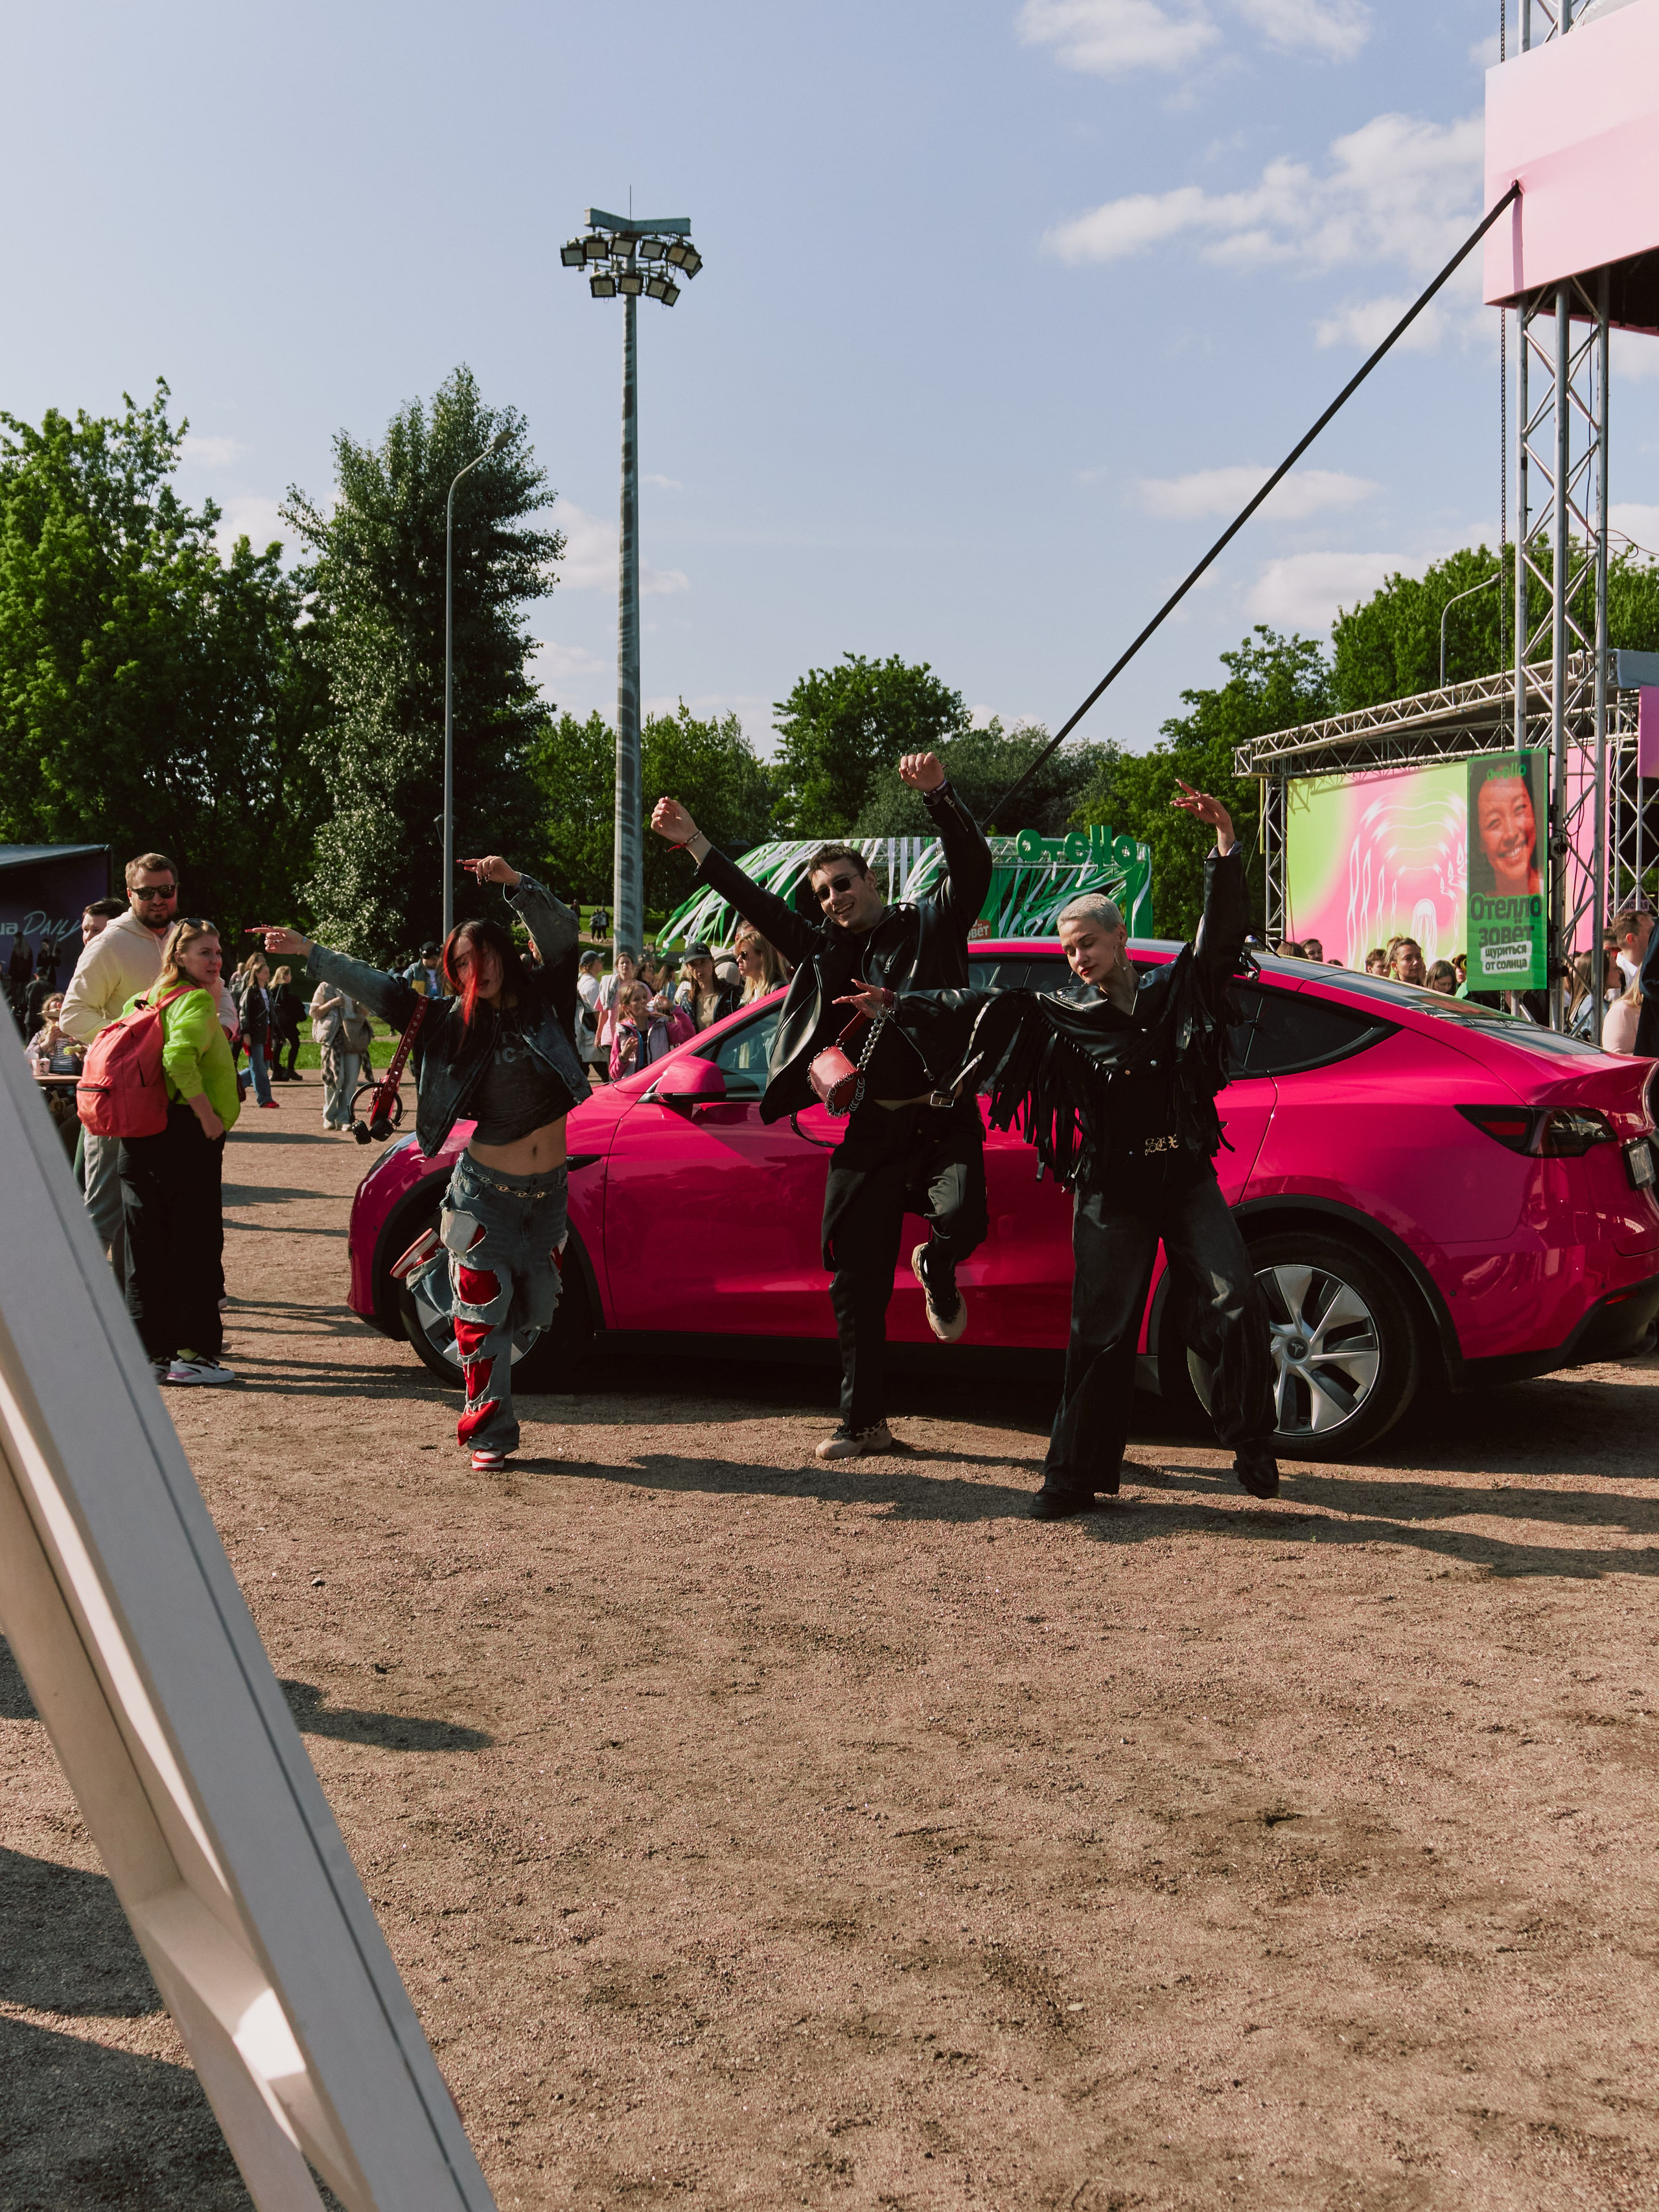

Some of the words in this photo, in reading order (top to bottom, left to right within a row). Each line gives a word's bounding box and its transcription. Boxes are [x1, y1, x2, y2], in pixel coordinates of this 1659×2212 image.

[1470, 894, 1543, 920] Отелло
[1478, 918, 1535, 947] зовёт
[1485, 944, 1527, 959] щуриться
[1485, 961, 1495, 970] от
[1496, 959, 1527, 970] солнца
